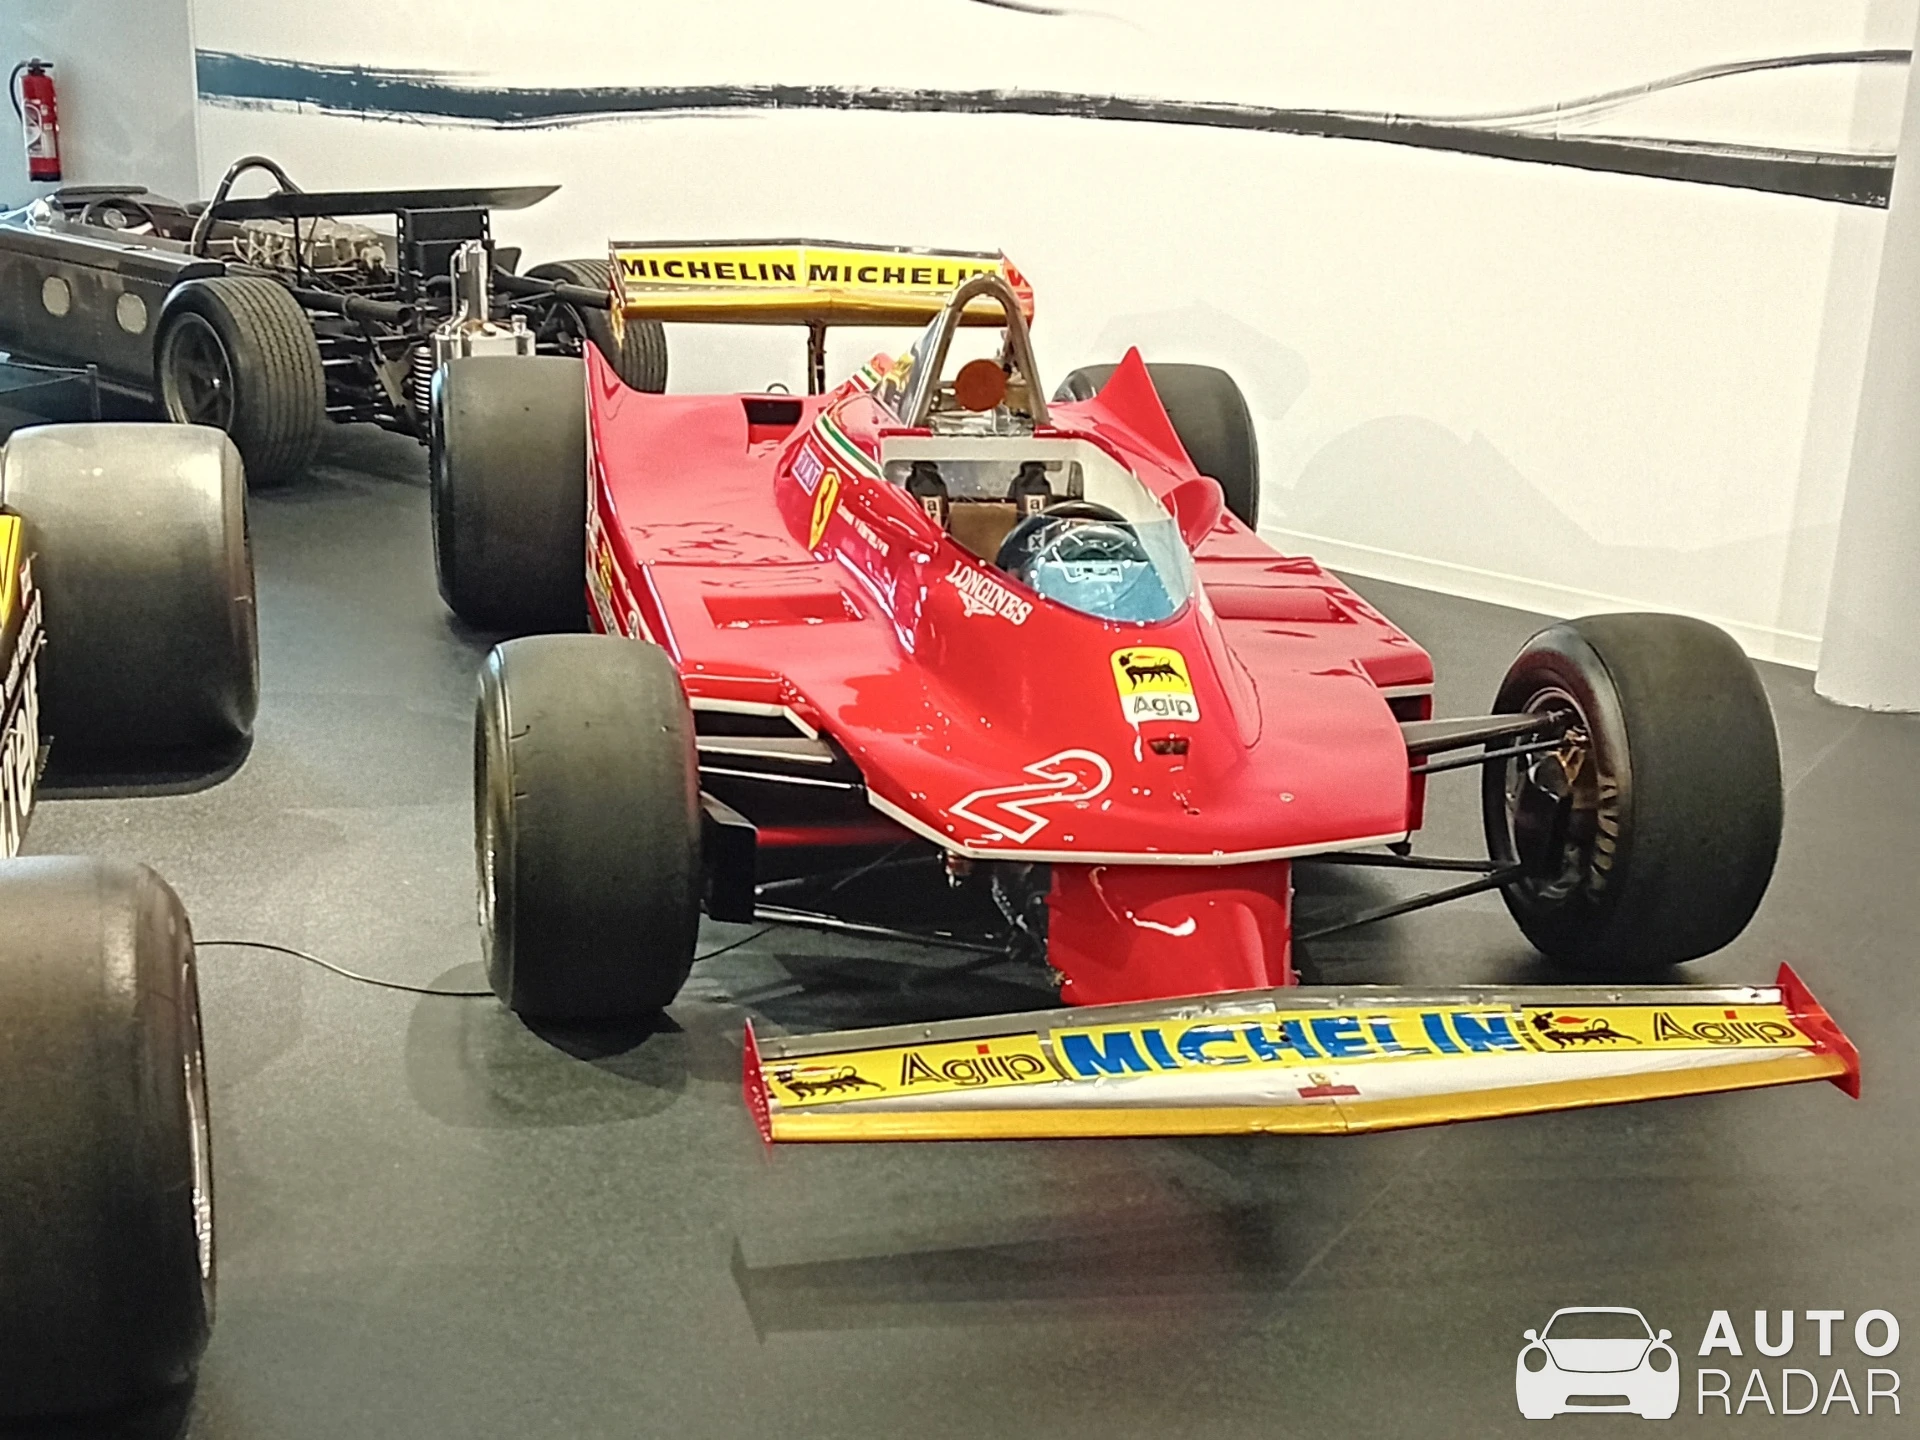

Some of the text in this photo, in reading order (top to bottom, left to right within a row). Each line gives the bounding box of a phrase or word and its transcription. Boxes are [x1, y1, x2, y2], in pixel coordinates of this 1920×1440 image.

[620, 258, 796, 281] MICHELIN
[945, 560, 1033, 625] LONGINES
[1133, 694, 1193, 716] Agip
[949, 749, 1112, 844] 2
[1061, 1012, 1521, 1076] MICHELIN
[1653, 1010, 1796, 1044] Agip
[900, 1044, 1045, 1085] Agip
